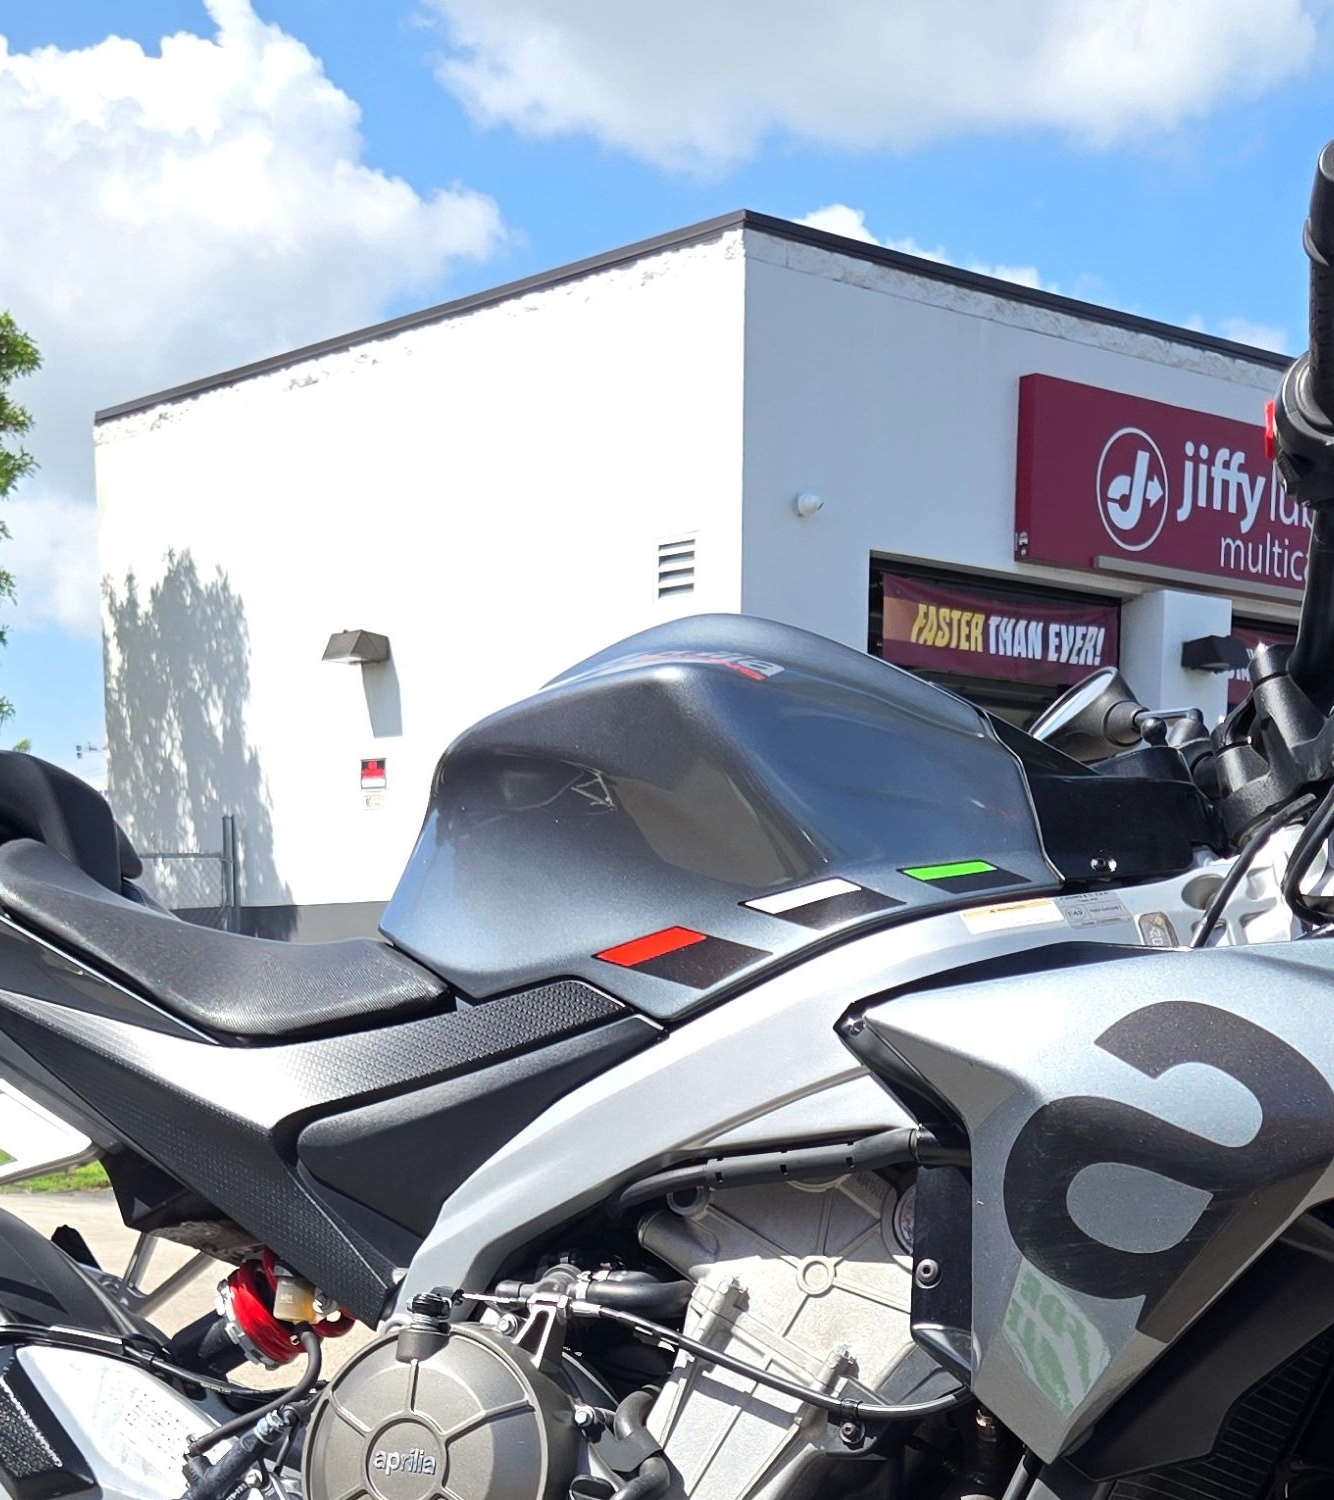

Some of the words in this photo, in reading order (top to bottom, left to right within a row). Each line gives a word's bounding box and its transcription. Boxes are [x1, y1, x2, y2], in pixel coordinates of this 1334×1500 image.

[1177, 440, 1266, 534] jiffy
[1220, 532, 1309, 582] multic
[910, 603, 985, 653] FASTER
[988, 615, 1043, 660] THAN
[1048, 623, 1105, 666] EVER!
[373, 1448, 436, 1477] aprilia
